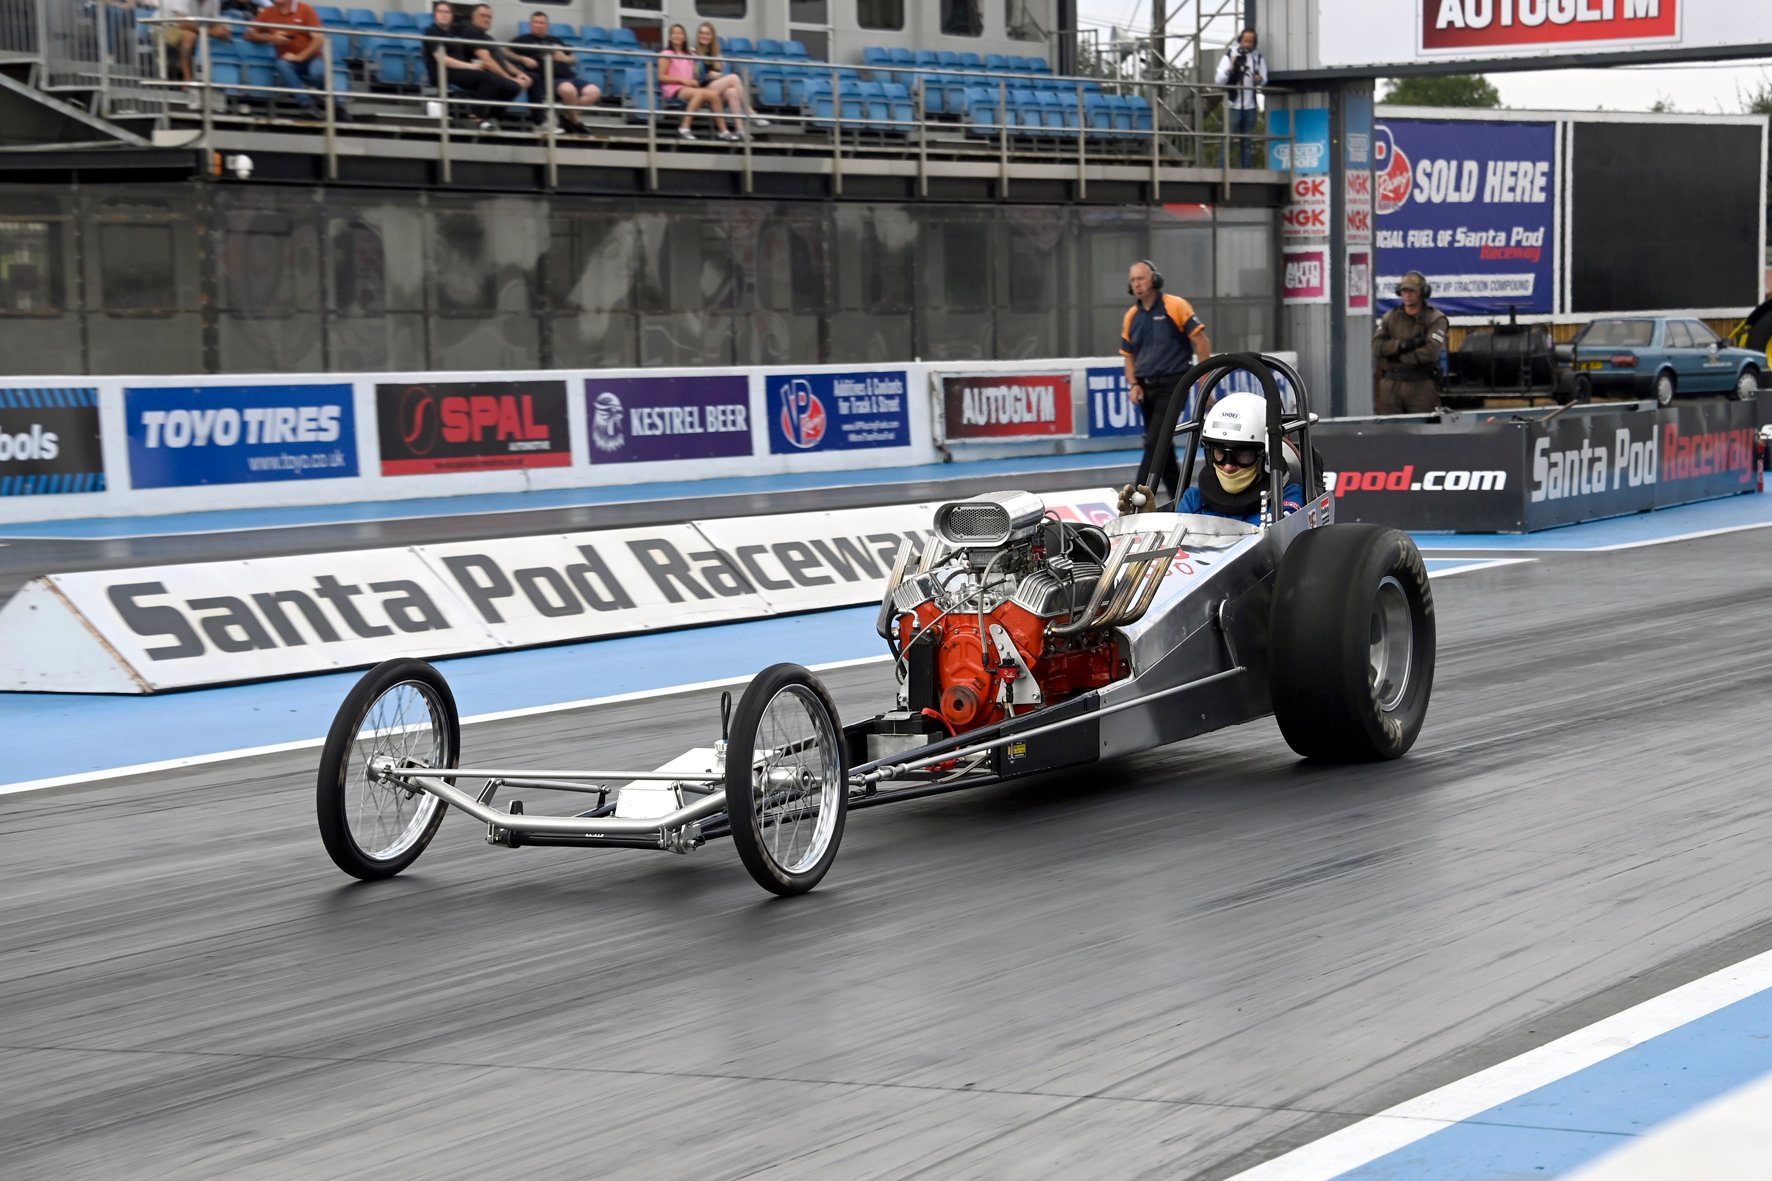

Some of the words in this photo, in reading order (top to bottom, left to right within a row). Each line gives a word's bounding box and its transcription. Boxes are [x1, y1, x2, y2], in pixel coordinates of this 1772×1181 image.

[1295, 179, 1326, 197] GK
[1347, 174, 1369, 195] NGK
[1413, 159, 1478, 203] SOLD
[1484, 161, 1549, 203] HERE
[1281, 209, 1326, 227] NGK
[1347, 210, 1369, 231] NGK
[1376, 230, 1404, 248] ICIAL
[1407, 230, 1434, 248] FUEL
[1437, 229, 1453, 247] OF
[1454, 227, 1506, 247] Santa
[1510, 226, 1545, 246] Pod
[1480, 246, 1542, 263] Raceway
[1490, 279, 1530, 291] COMPOUND
[441, 395, 549, 443] SPAL
[630, 406, 704, 436] KESTREL
[705, 404, 748, 432] BEER
[962, 385, 1056, 426] AUTOGLYM
[0, 423, 60, 461] ools
[142, 408, 241, 448] TOYO
[243, 405, 341, 444] TIRES
[1531, 436, 1608, 502] Santa
[1613, 425, 1658, 491] Pod
[1663, 423, 1754, 484] Raceway
[1323, 465, 1507, 498] apod.com
[107, 574, 451, 661] Santa
[441, 545, 637, 624] Pod
